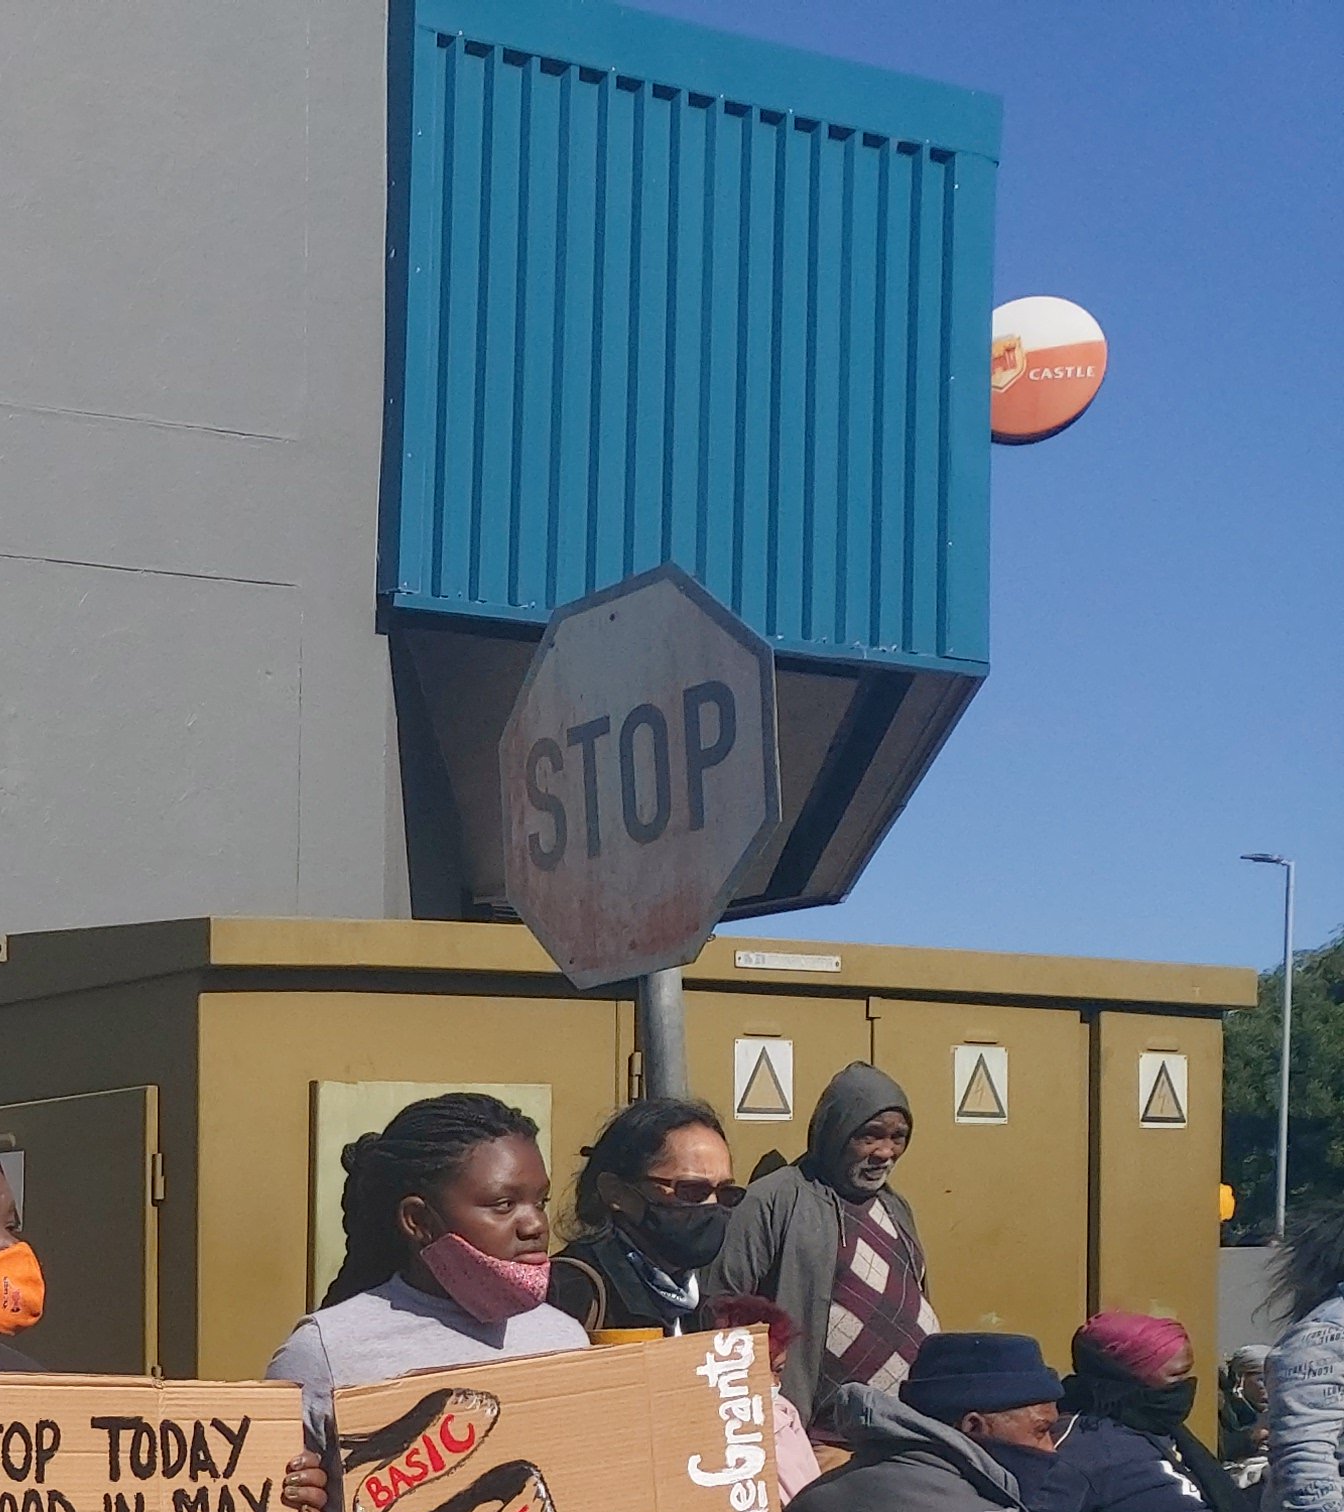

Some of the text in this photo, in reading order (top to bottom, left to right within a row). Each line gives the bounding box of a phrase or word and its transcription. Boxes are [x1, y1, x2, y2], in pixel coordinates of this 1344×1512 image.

[1029, 366, 1096, 381] CASTLE
[526, 679, 737, 871] STOP
[91, 1415, 251, 1481] TODAY
[364, 1414, 475, 1508] BASIC
